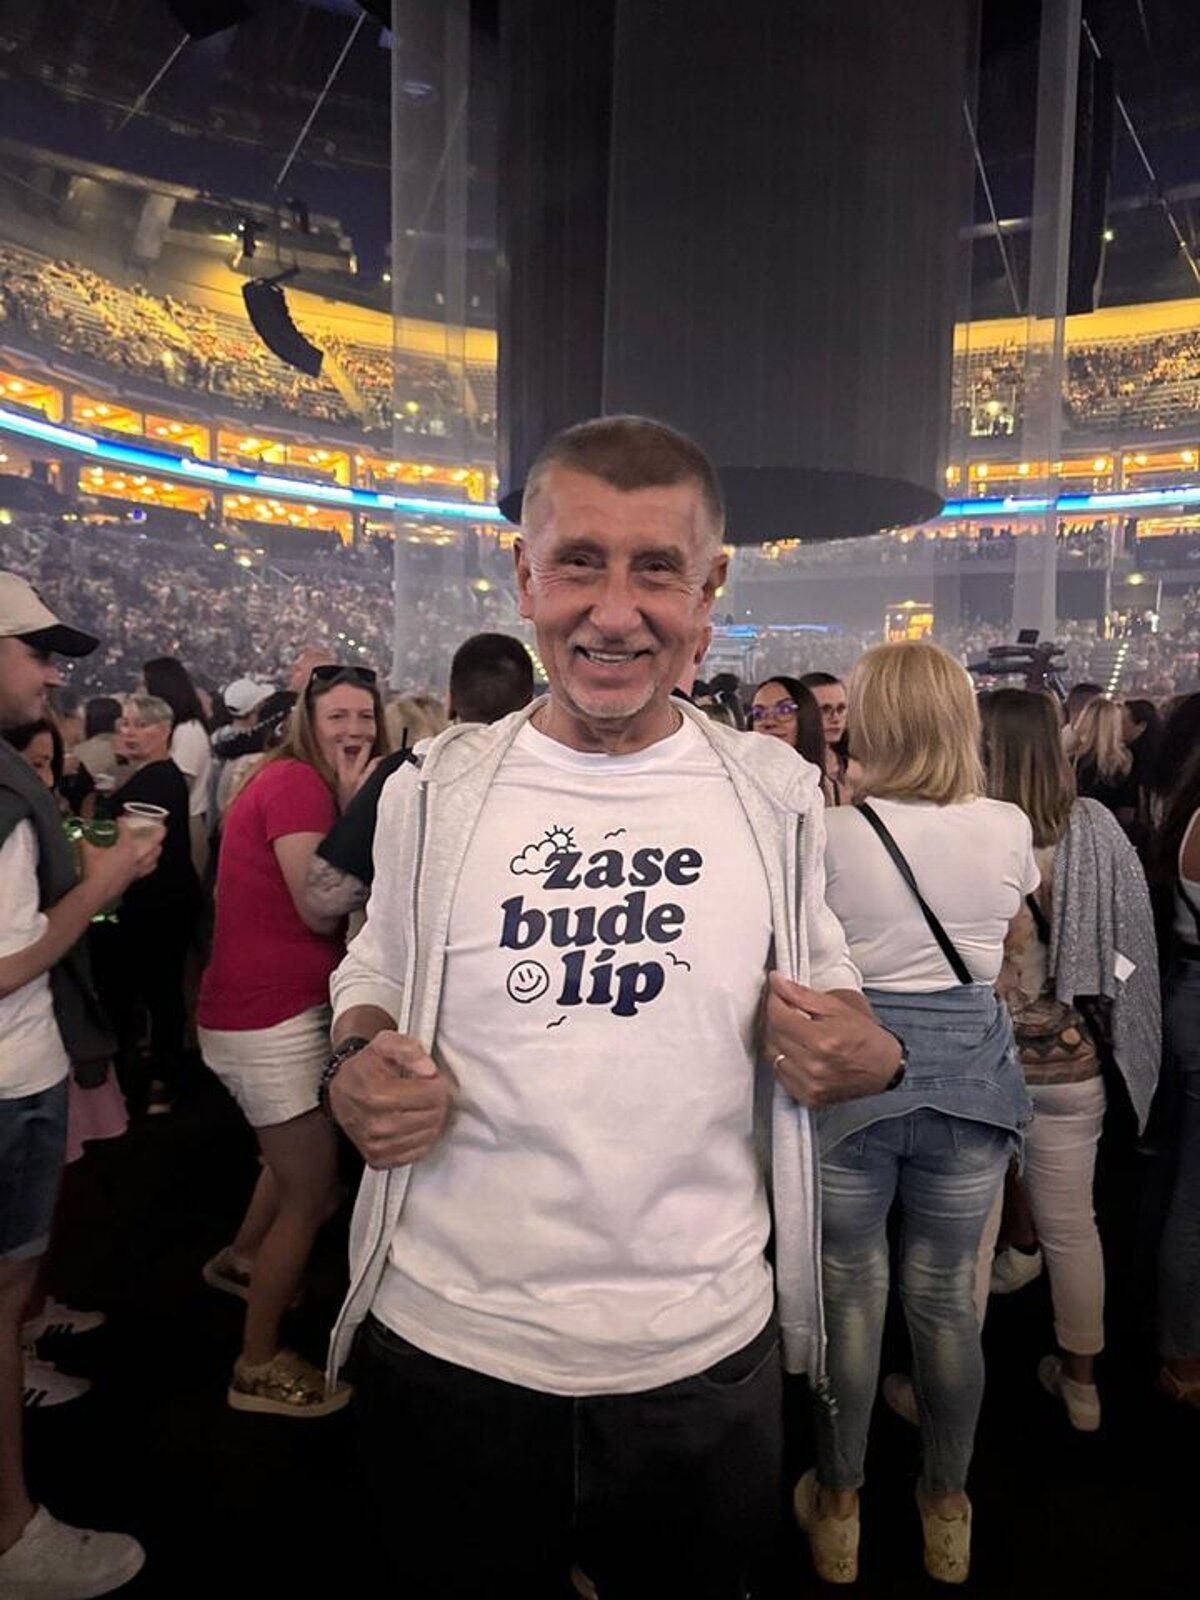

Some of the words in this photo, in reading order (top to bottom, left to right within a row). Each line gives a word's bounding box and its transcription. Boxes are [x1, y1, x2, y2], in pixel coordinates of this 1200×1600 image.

[543, 848, 703, 889] zase
[499, 891, 685, 950] bude
[556, 949, 665, 1017] líp
